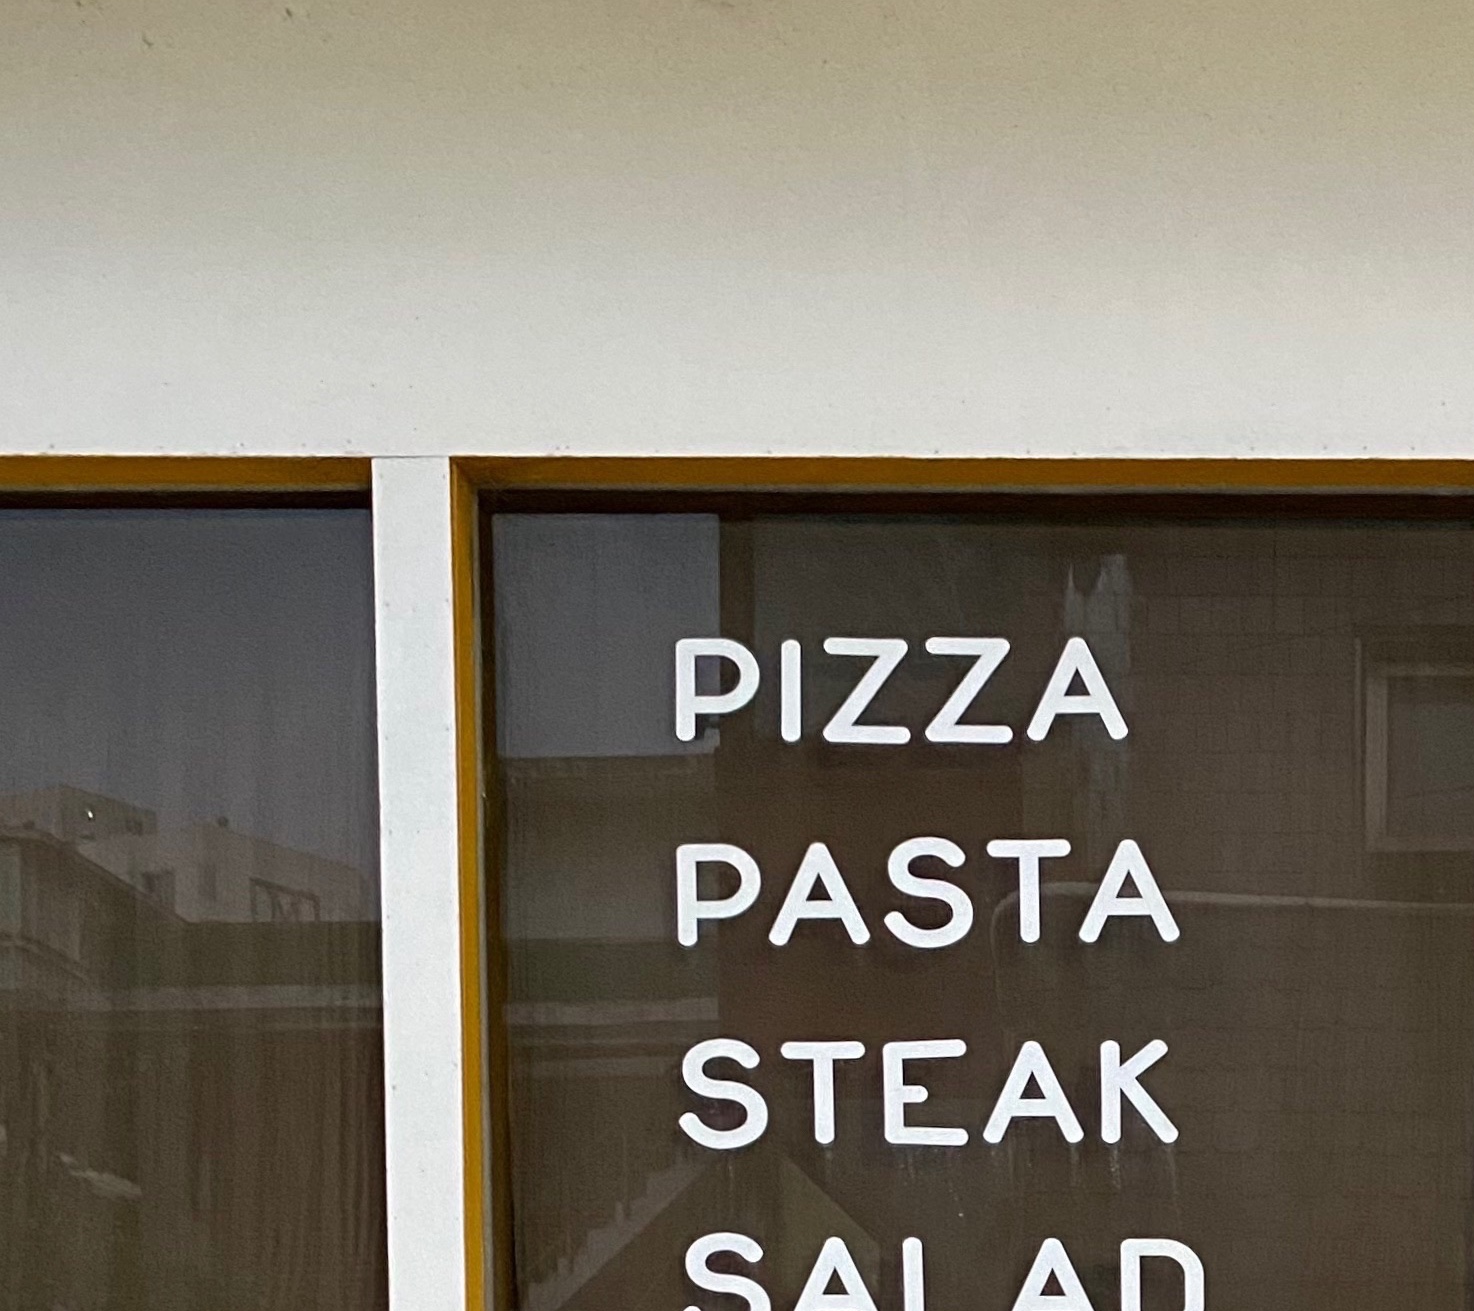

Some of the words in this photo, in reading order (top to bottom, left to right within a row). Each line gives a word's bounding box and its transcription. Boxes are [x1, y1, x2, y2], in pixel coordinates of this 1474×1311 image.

[675, 636, 1129, 744] PIZZA
[676, 837, 1180, 948] PASTA
[679, 1038, 1179, 1149] STEAK
